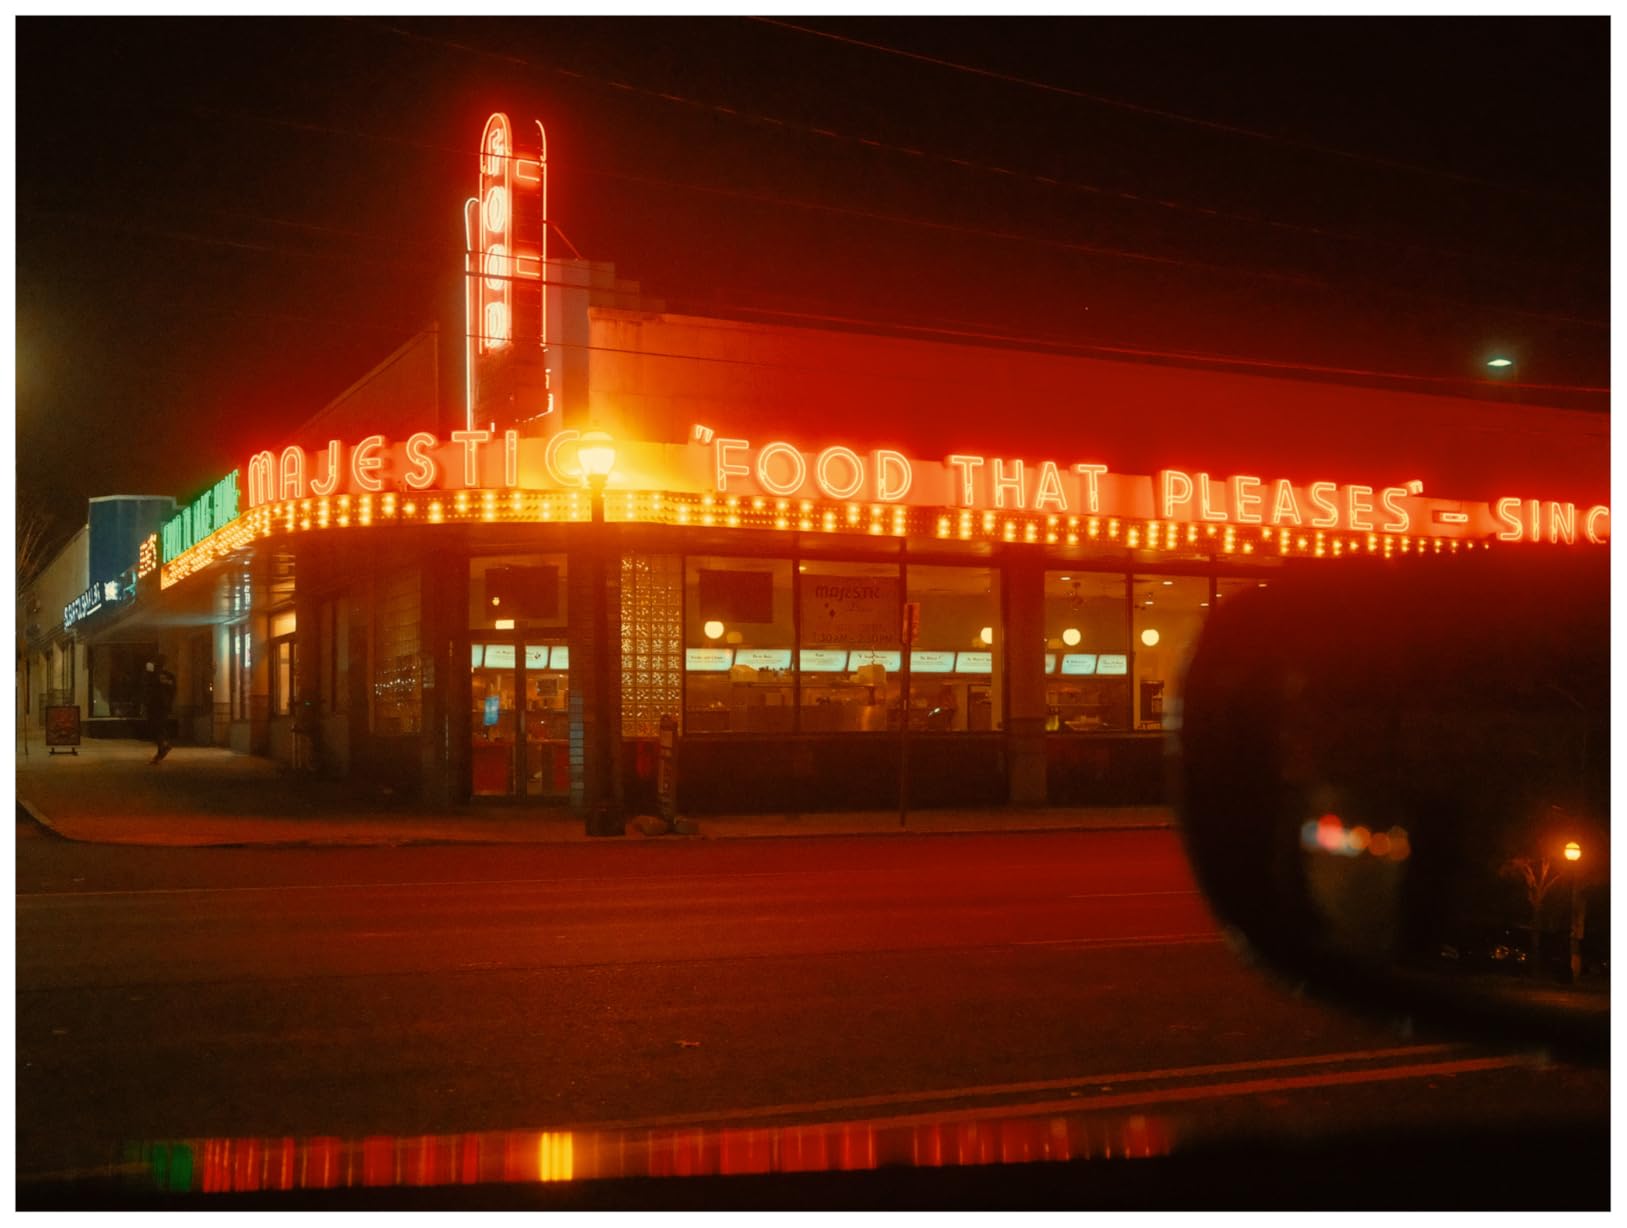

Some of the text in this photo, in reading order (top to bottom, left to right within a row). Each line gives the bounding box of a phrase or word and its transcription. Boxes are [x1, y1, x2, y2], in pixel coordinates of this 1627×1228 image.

[485, 127, 508, 348] FOOD
[249, 430, 583, 506] MAJESTIC
[949, 454, 1108, 512] THAT
